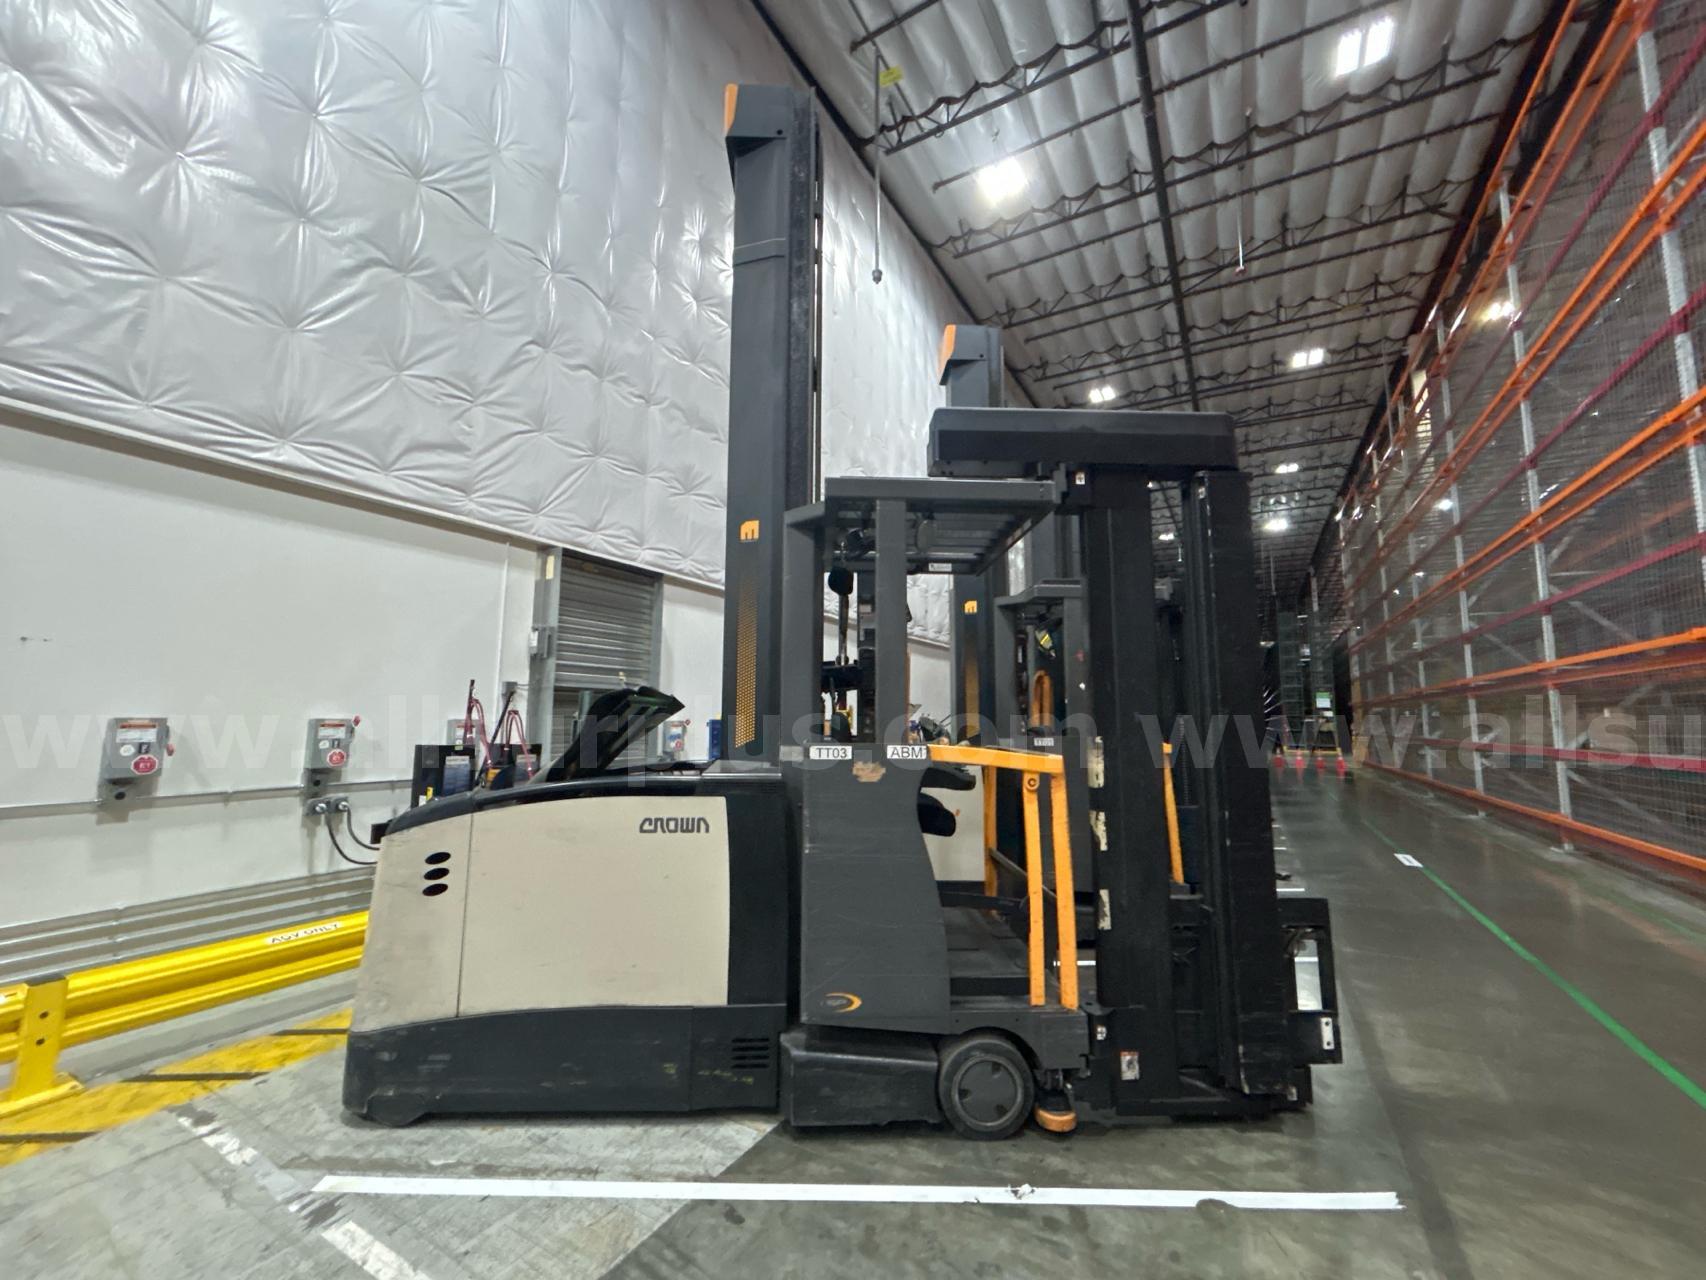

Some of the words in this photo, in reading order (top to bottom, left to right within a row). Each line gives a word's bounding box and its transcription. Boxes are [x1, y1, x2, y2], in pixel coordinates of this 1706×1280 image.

[816, 747, 848, 759] TT03
[891, 747, 923, 759] ABM
[639, 816, 709, 833] CROWN
[303, 924, 338, 935] ONLY
